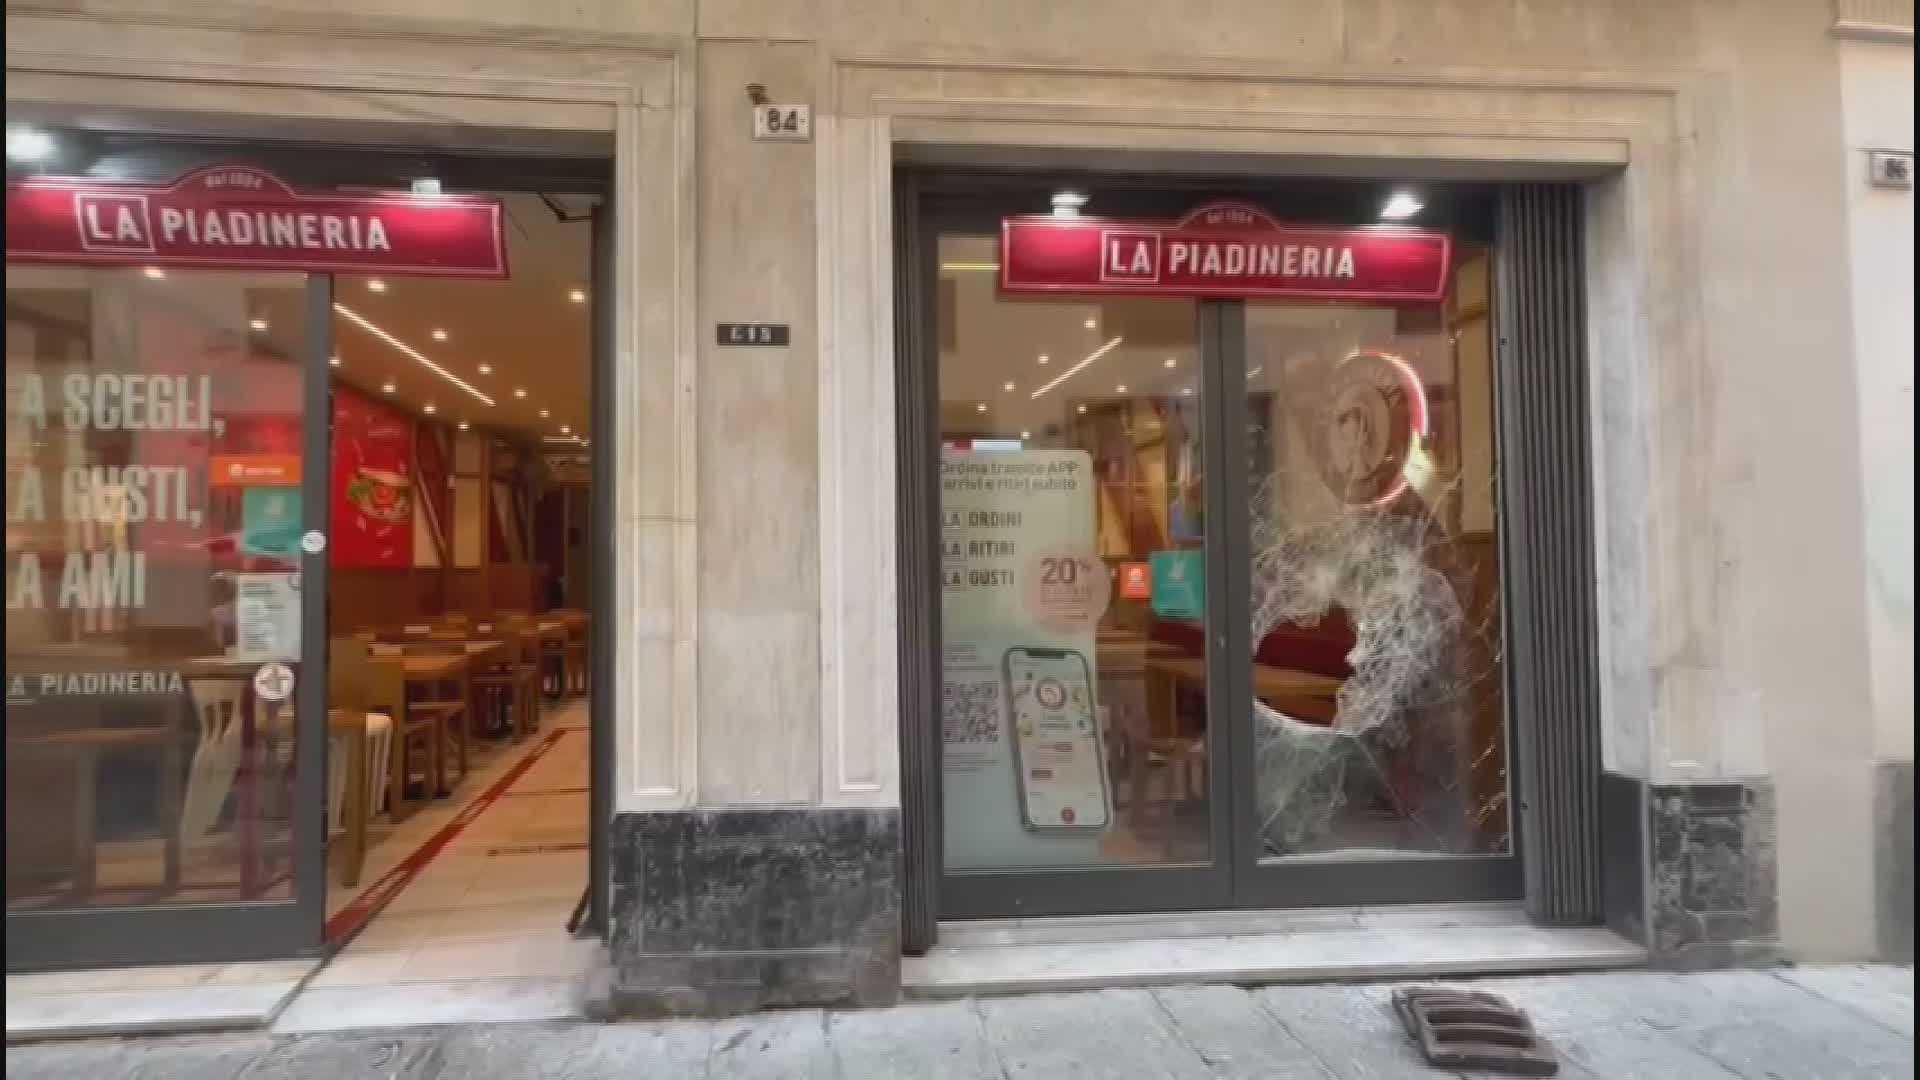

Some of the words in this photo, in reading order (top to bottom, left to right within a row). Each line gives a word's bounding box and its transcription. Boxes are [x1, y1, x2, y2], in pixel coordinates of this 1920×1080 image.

[767, 108, 798, 132] 84
[86, 204, 141, 241] LA
[160, 207, 391, 251] PIADINERIA
[1111, 240, 1151, 273] LA
[1168, 243, 1354, 278] PIADINERIA
[62, 373, 225, 437] SCEGLI,
[62, 465, 202, 528] GUSTI,
[968, 511, 1022, 528] ORDINI
[968, 540, 1015, 557] RITIRI
[59, 551, 145, 608] AMI
[968, 570, 1015, 586] GUSTI
[40, 671, 185, 696] PIADINERIA
